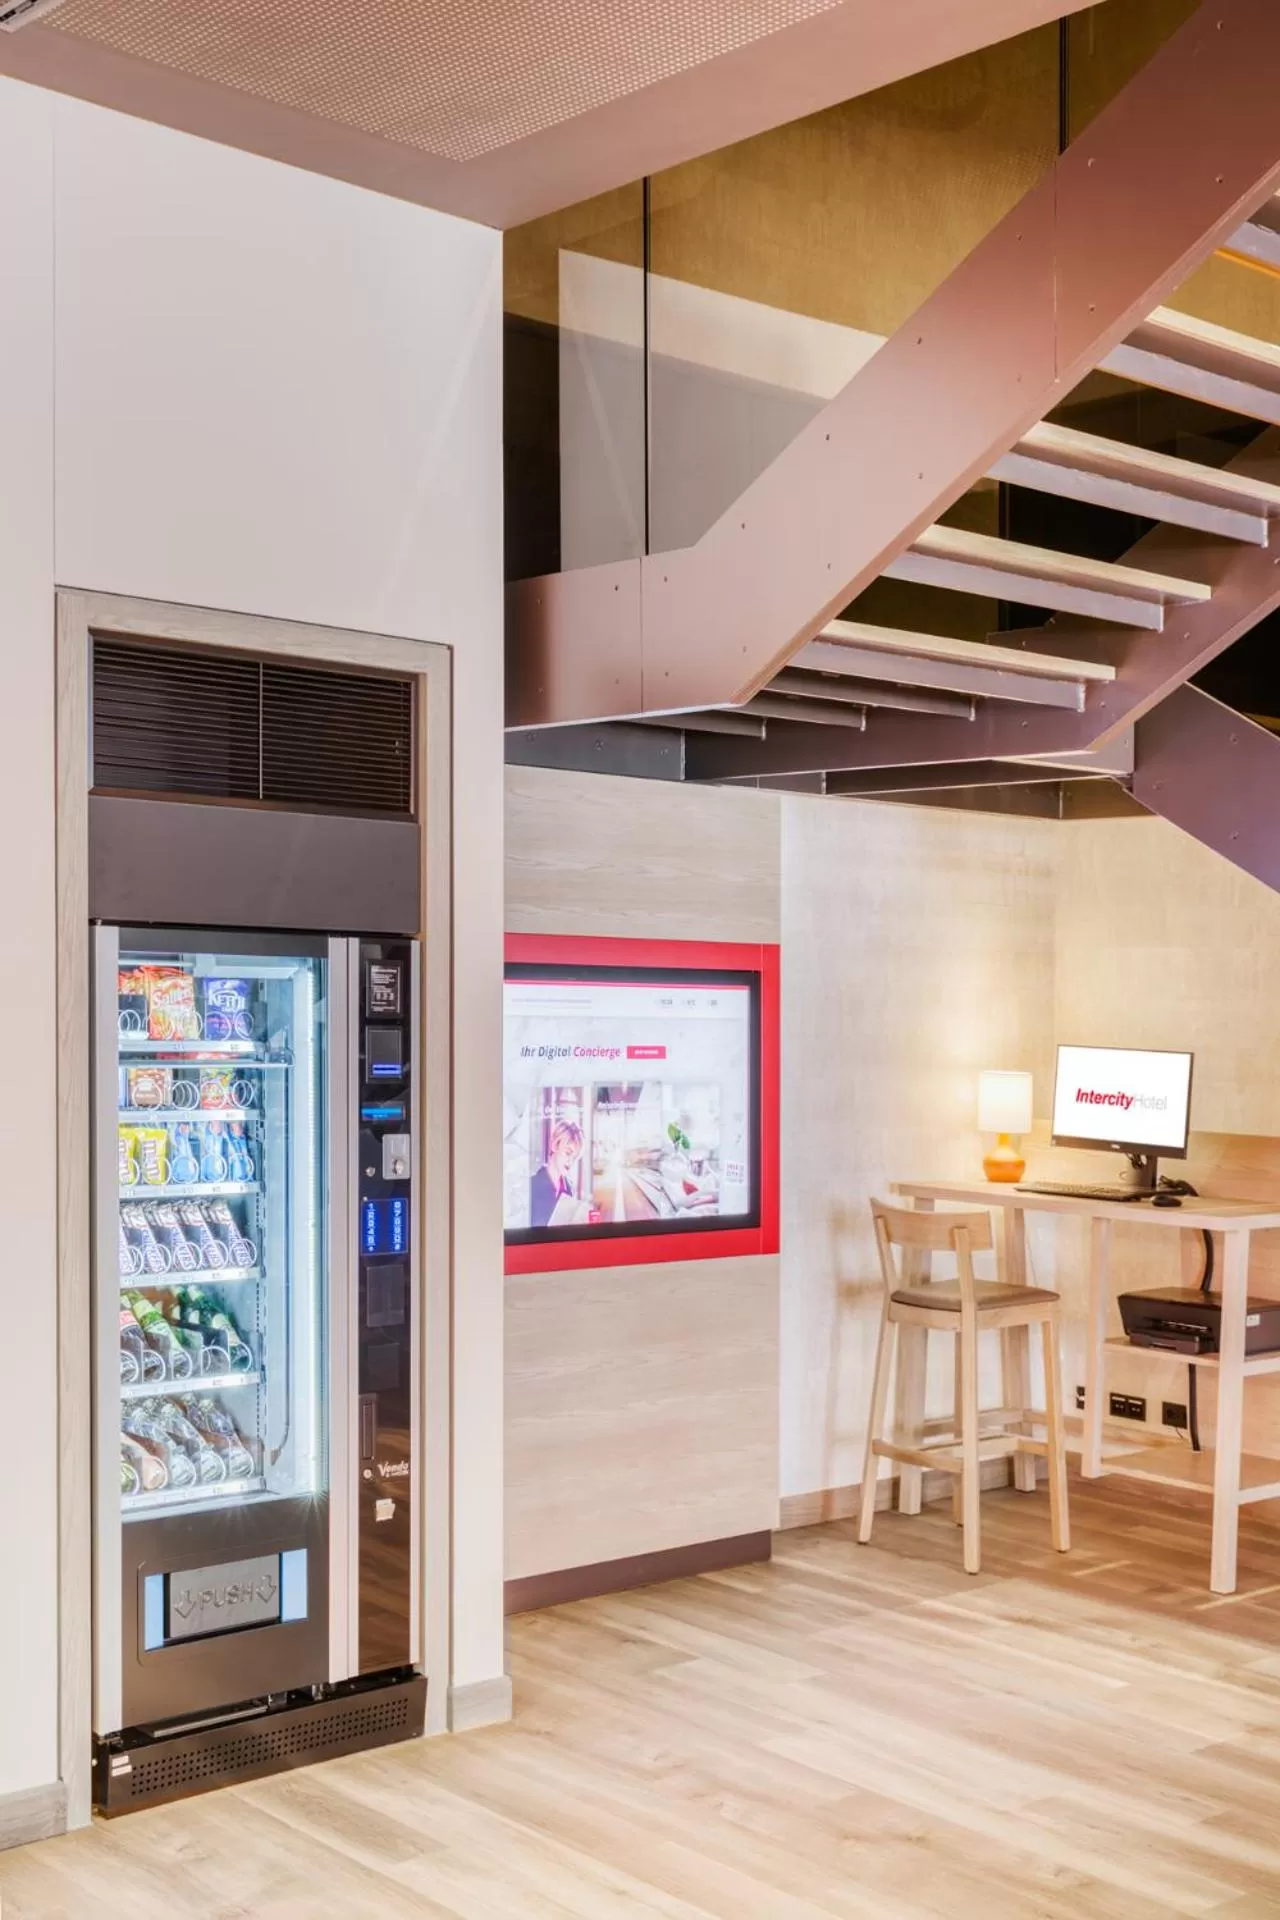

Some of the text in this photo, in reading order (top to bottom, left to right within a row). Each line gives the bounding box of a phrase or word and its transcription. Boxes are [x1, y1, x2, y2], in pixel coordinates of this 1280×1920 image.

[520, 1045, 535, 1058] Ihr
[538, 1046, 571, 1060] Digital
[573, 1046, 620, 1060] Concierge
[199, 1581, 254, 1611] PUSH
